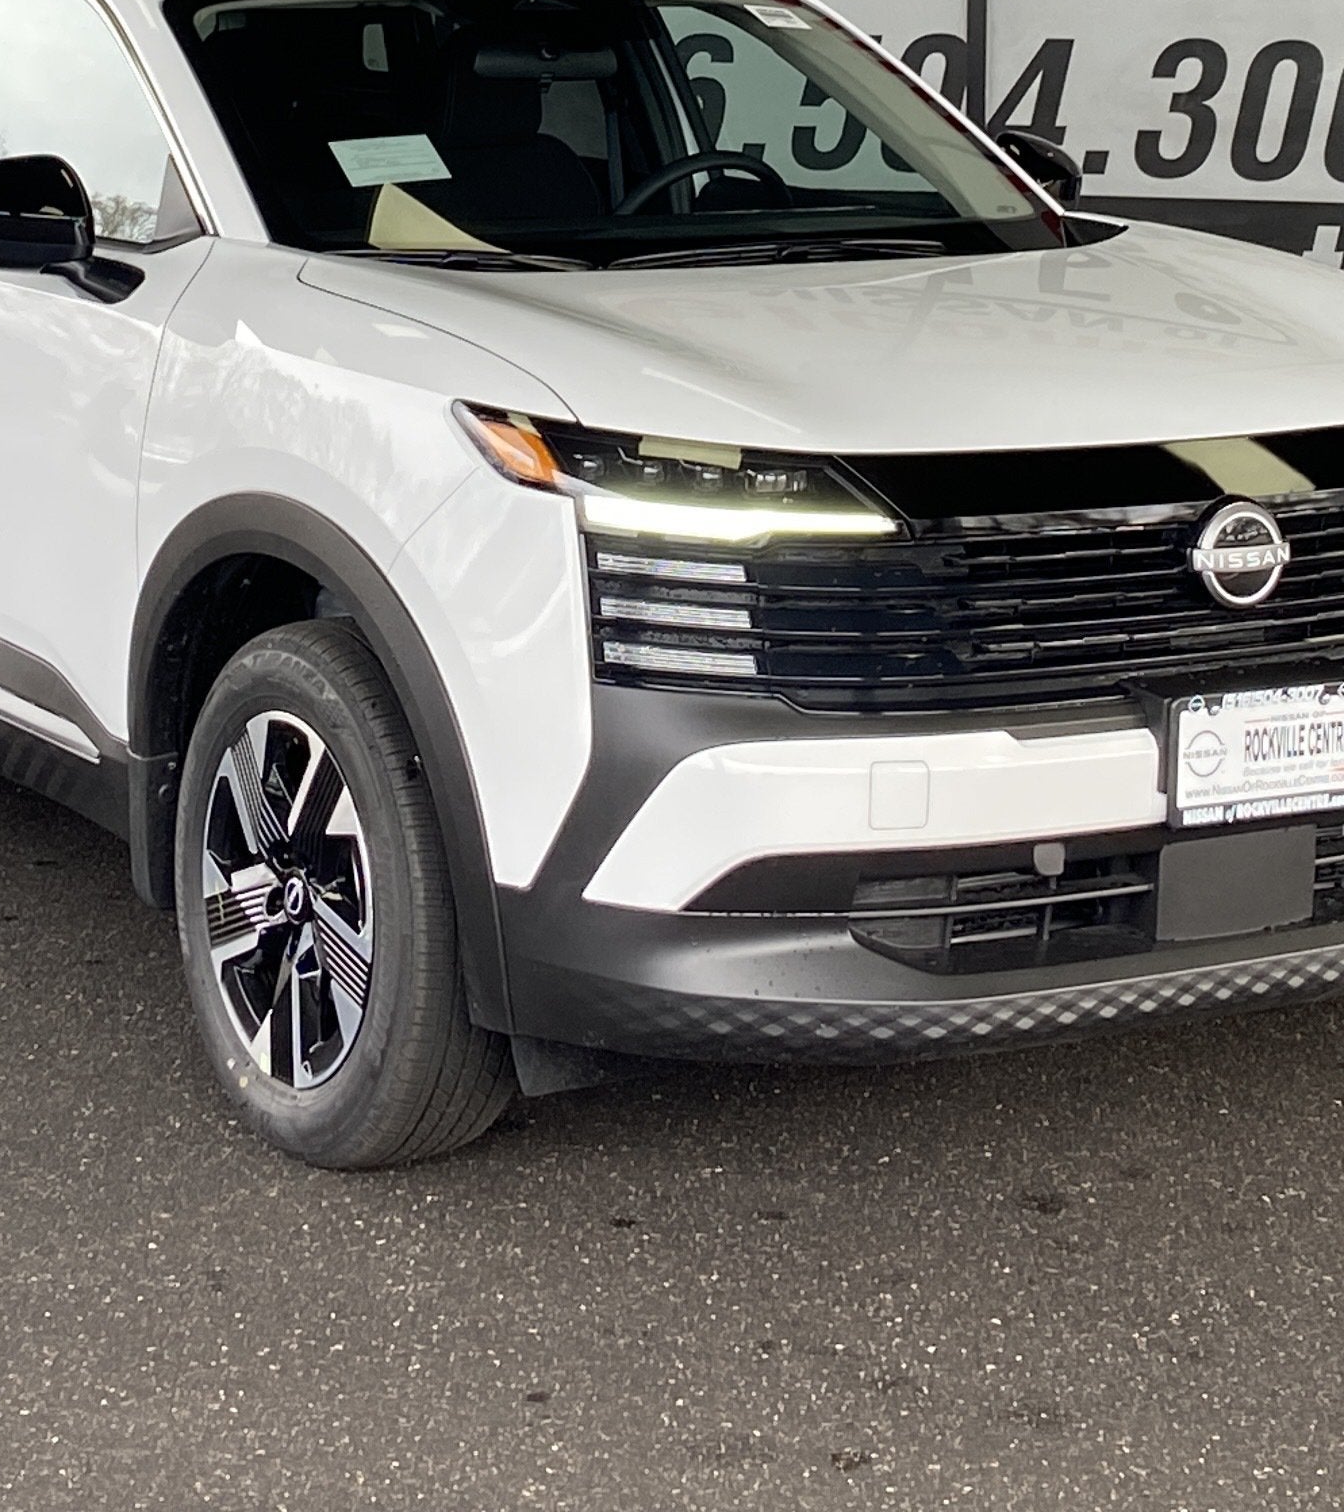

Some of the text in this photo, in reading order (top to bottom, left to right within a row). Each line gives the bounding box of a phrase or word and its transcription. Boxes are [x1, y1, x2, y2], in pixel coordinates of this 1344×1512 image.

[1195, 544, 1291, 570] NISSAN
[1183, 748, 1228, 760] NISSAN
[1244, 724, 1305, 763] ROCKVILLE
[1183, 805, 1224, 825] NISSAN
